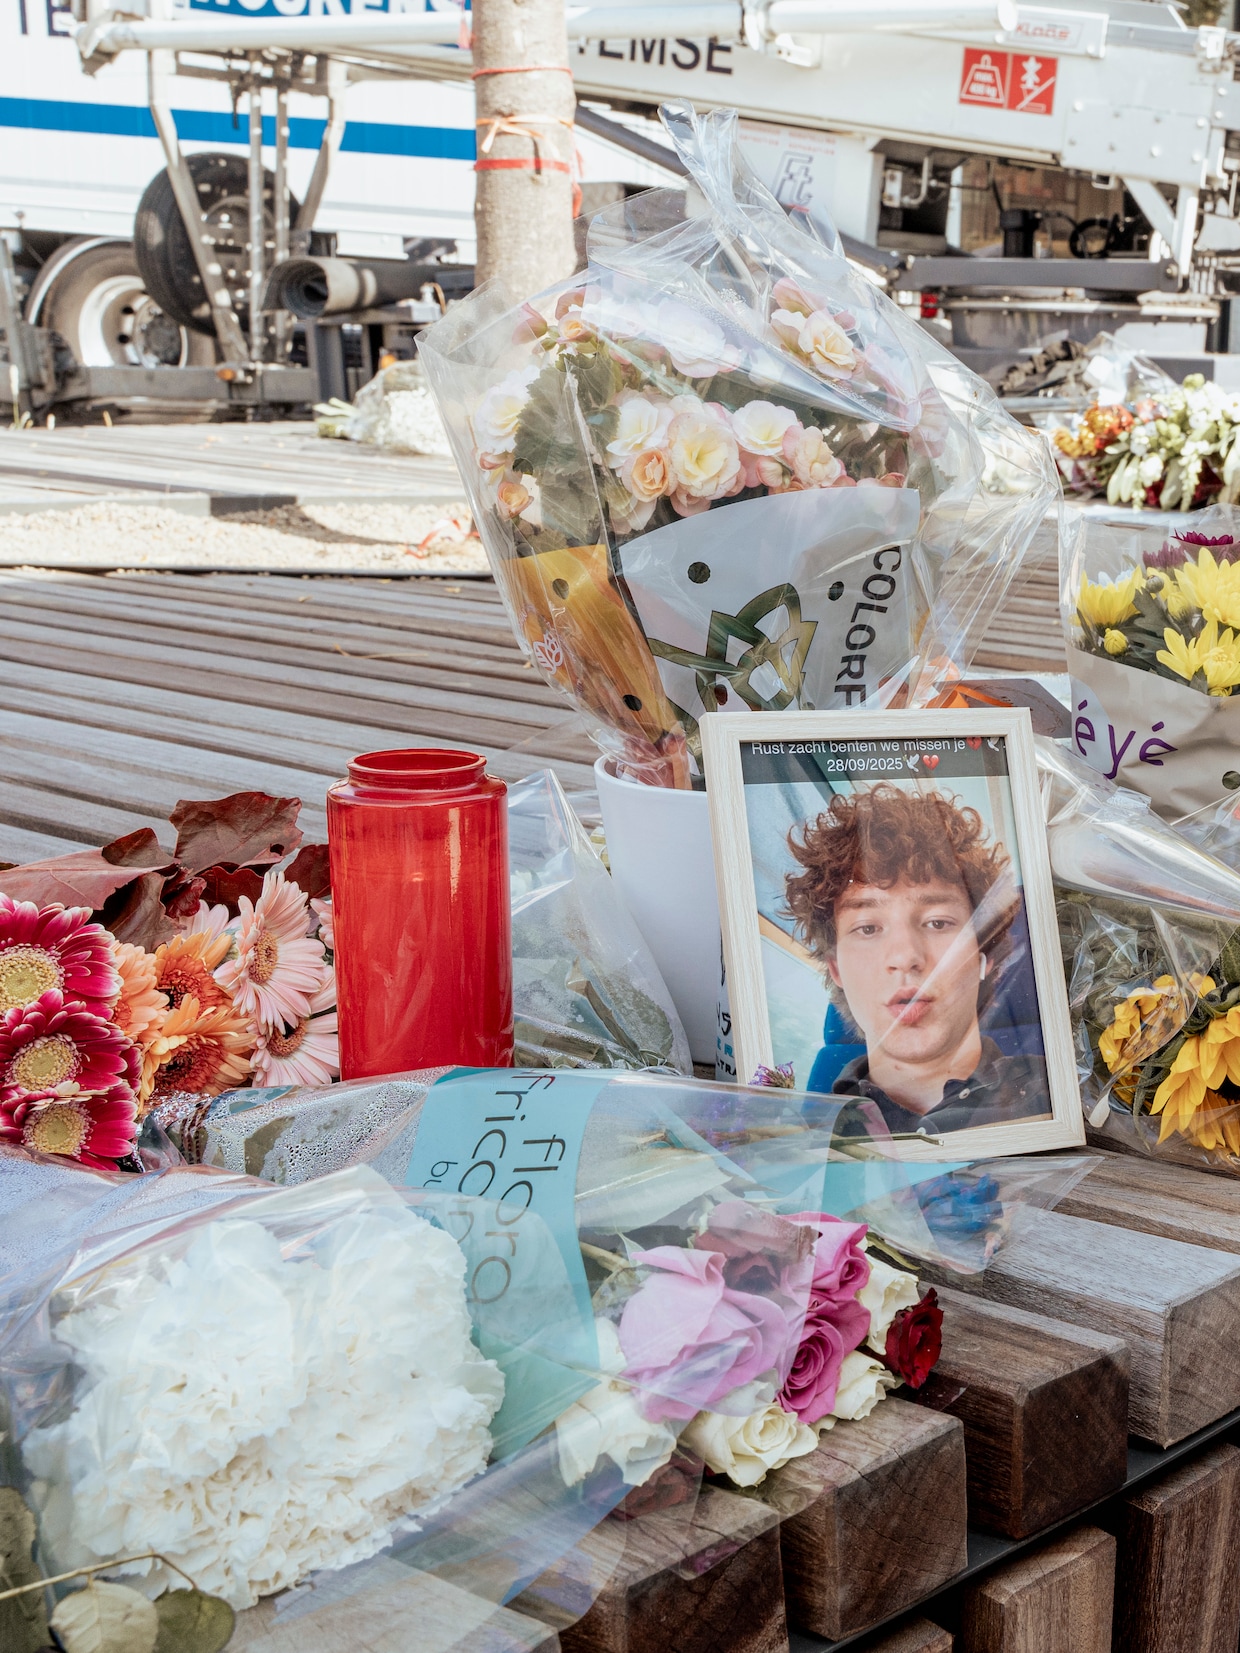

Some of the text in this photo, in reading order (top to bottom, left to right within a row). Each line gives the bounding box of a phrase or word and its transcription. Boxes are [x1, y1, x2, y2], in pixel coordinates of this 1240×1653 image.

[751, 738, 966, 755] Rust zacht benten we missen je
[826, 757, 903, 772] 28/09/2025
[471, 1133, 566, 1304] flora
